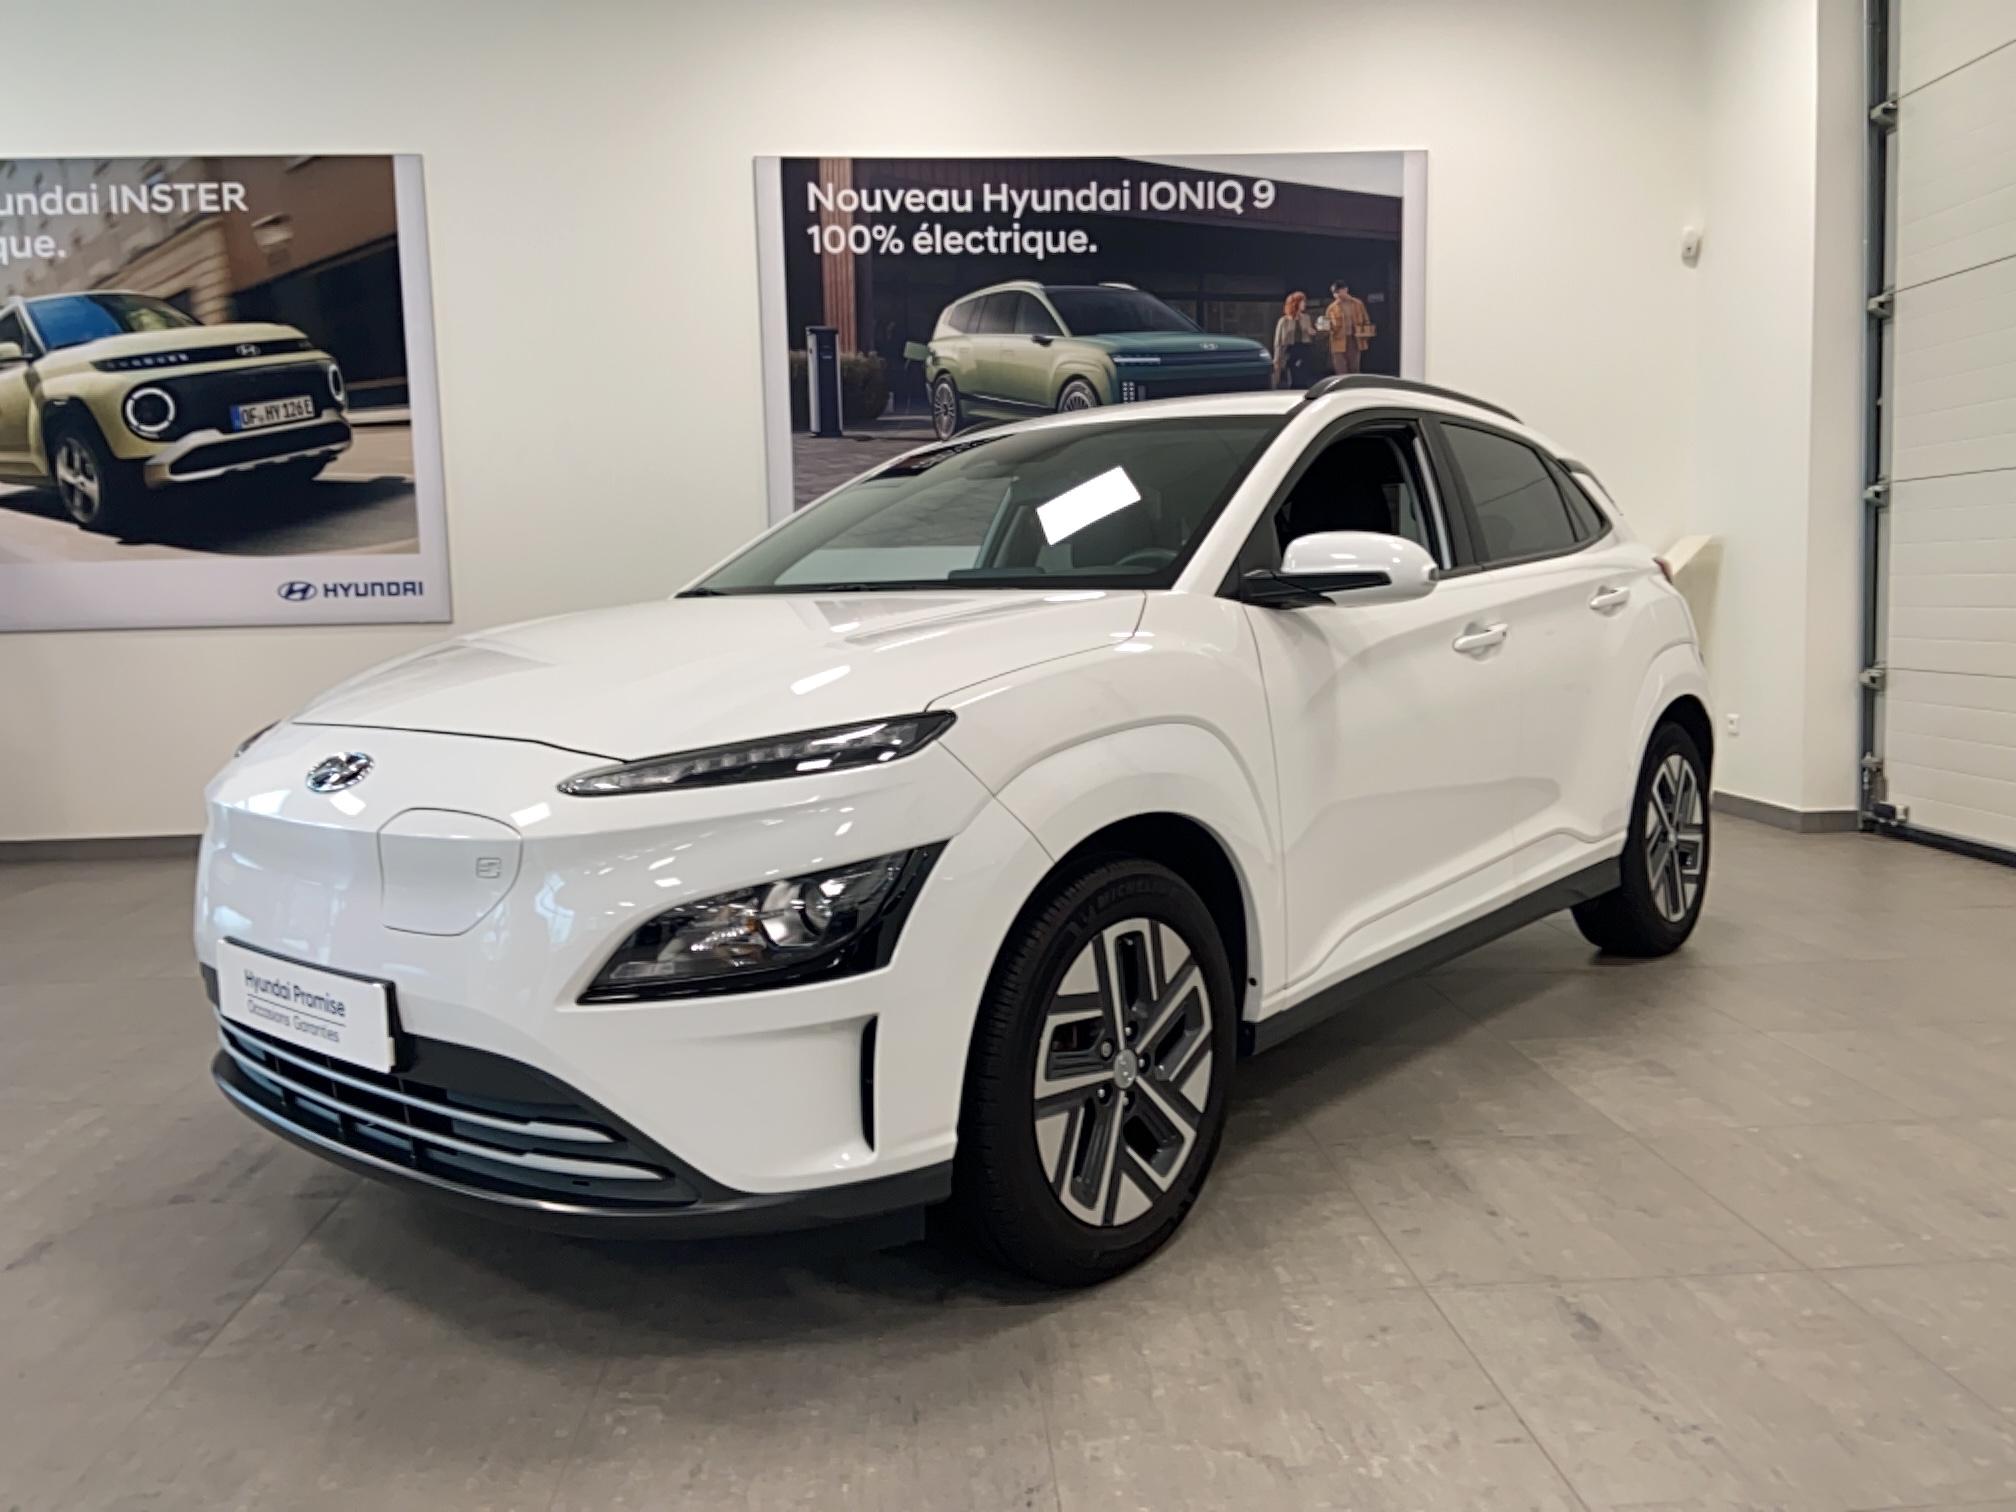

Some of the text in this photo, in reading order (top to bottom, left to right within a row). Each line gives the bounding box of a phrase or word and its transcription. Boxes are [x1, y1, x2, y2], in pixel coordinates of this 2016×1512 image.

[109, 181, 249, 214] INSTER
[806, 179, 1276, 219] Nouveau Hyundai IONIQ 9
[806, 222, 1098, 260] 100% électrique.
[323, 581, 424, 598] HYUNDAI
[243, 968, 346, 1018] Hyundai Promise
